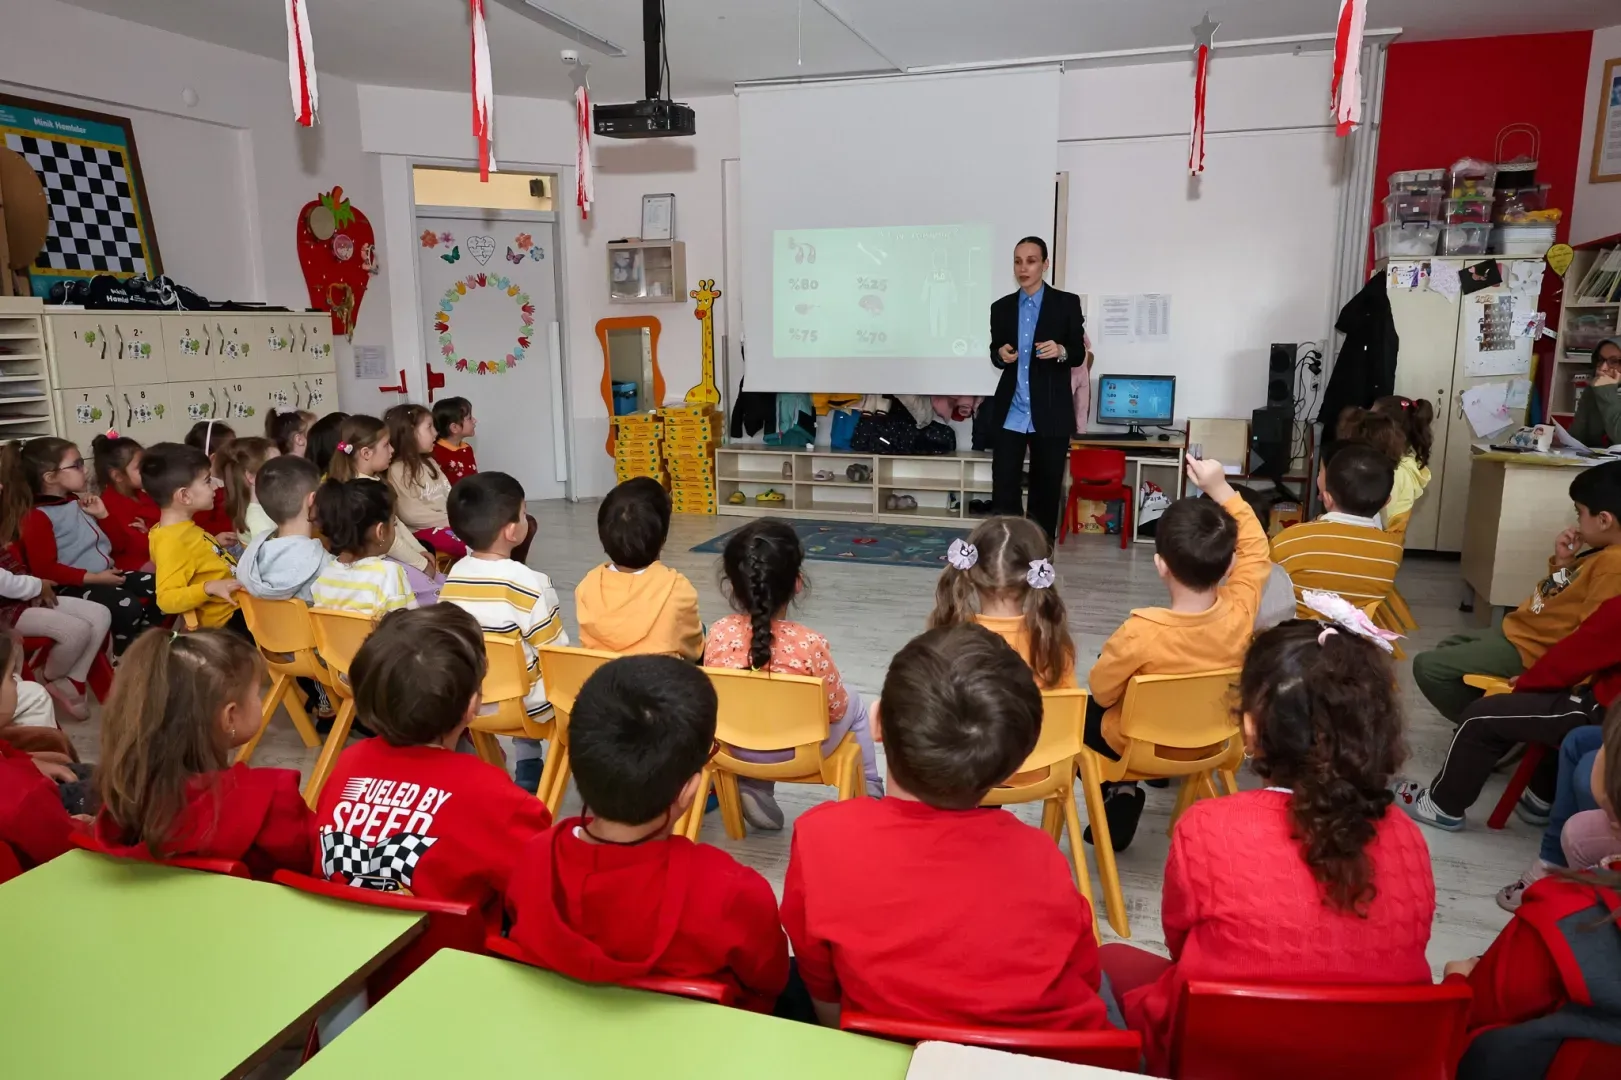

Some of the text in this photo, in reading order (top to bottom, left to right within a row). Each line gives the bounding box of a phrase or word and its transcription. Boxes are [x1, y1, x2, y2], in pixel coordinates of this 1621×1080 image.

[33, 117, 54, 128] Minik
[74, 331, 78, 339] 1
[133, 329, 139, 337] 2
[185, 328, 190, 336] 3
[233, 327, 238, 335] 4
[315, 378, 323, 386] 12
[233, 384, 242, 392] 10
[83, 394, 88, 402] 7
[140, 391, 146, 399] 8
[189, 391, 195, 399] 9
[345, 777, 452, 815] FUELED BY
[324, 801, 434, 843] SPEED
